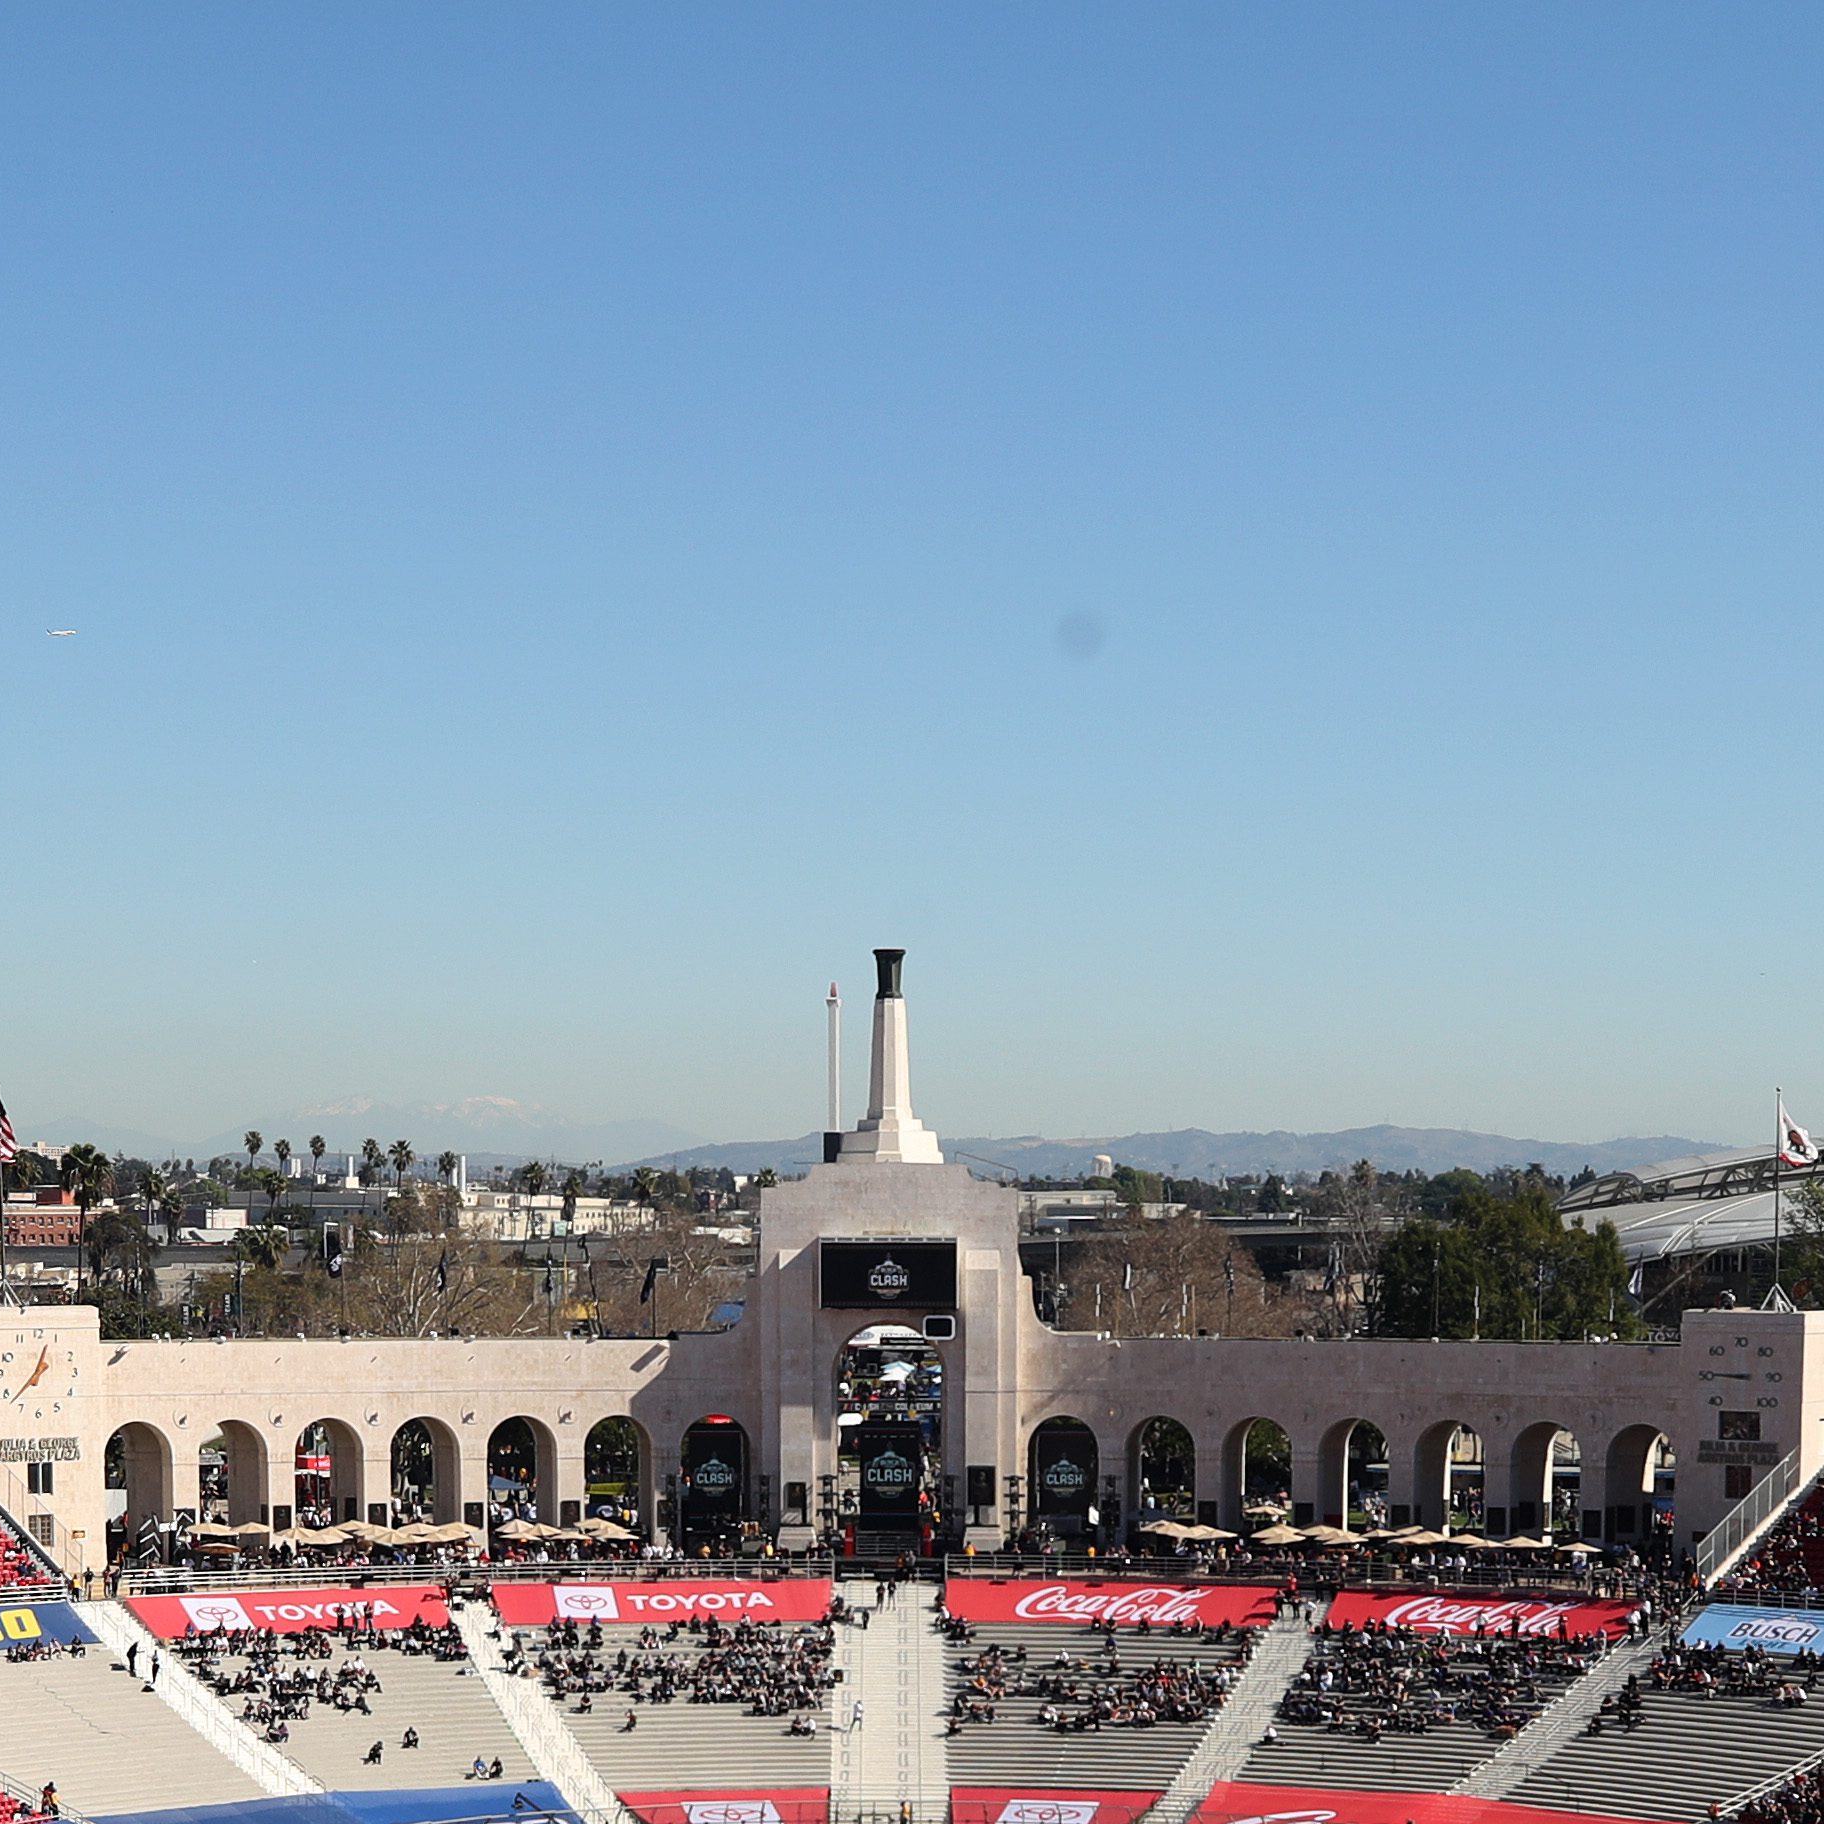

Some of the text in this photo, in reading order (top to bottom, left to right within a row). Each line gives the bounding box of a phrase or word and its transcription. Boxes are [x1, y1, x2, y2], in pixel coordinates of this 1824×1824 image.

[870, 1275, 908, 1286] CLASH
[1735, 1337, 1748, 1347] 70
[1709, 1346, 1725, 1356] 60
[1758, 1347, 1773, 1357] 80
[1765, 1372, 1782, 1383] 90
[1757, 1397, 1778, 1408] 100
[0, 1437, 79, 1451] JULIA GEORGE
[867, 1468, 913, 1482] CLASH
[627, 1591, 774, 1611] TOYOTA
[1015, 1586, 1210, 1622] Coca-Cola
[1729, 1622, 1822, 1643] BUSCH
